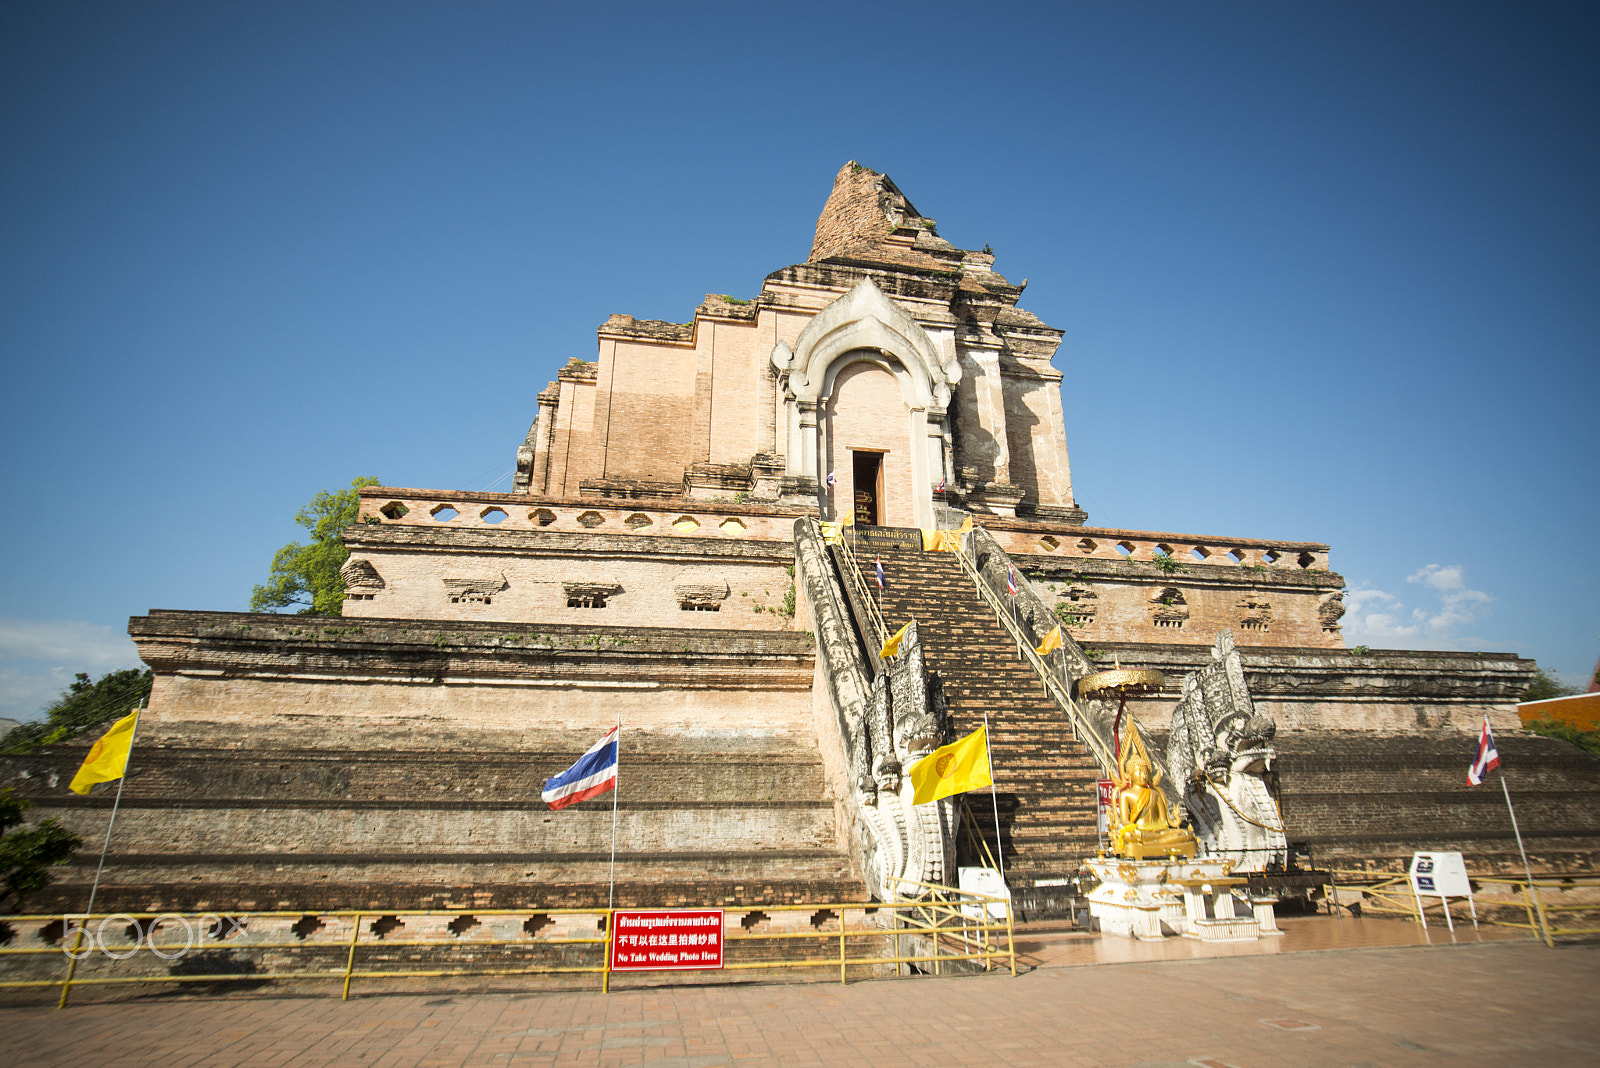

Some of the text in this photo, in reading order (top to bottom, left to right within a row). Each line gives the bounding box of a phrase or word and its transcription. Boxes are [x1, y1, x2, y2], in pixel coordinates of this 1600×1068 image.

[618, 933, 717, 947] 不可以在这里拍婚纱照
[618, 951, 718, 963] No Take Wedding Photo Here
